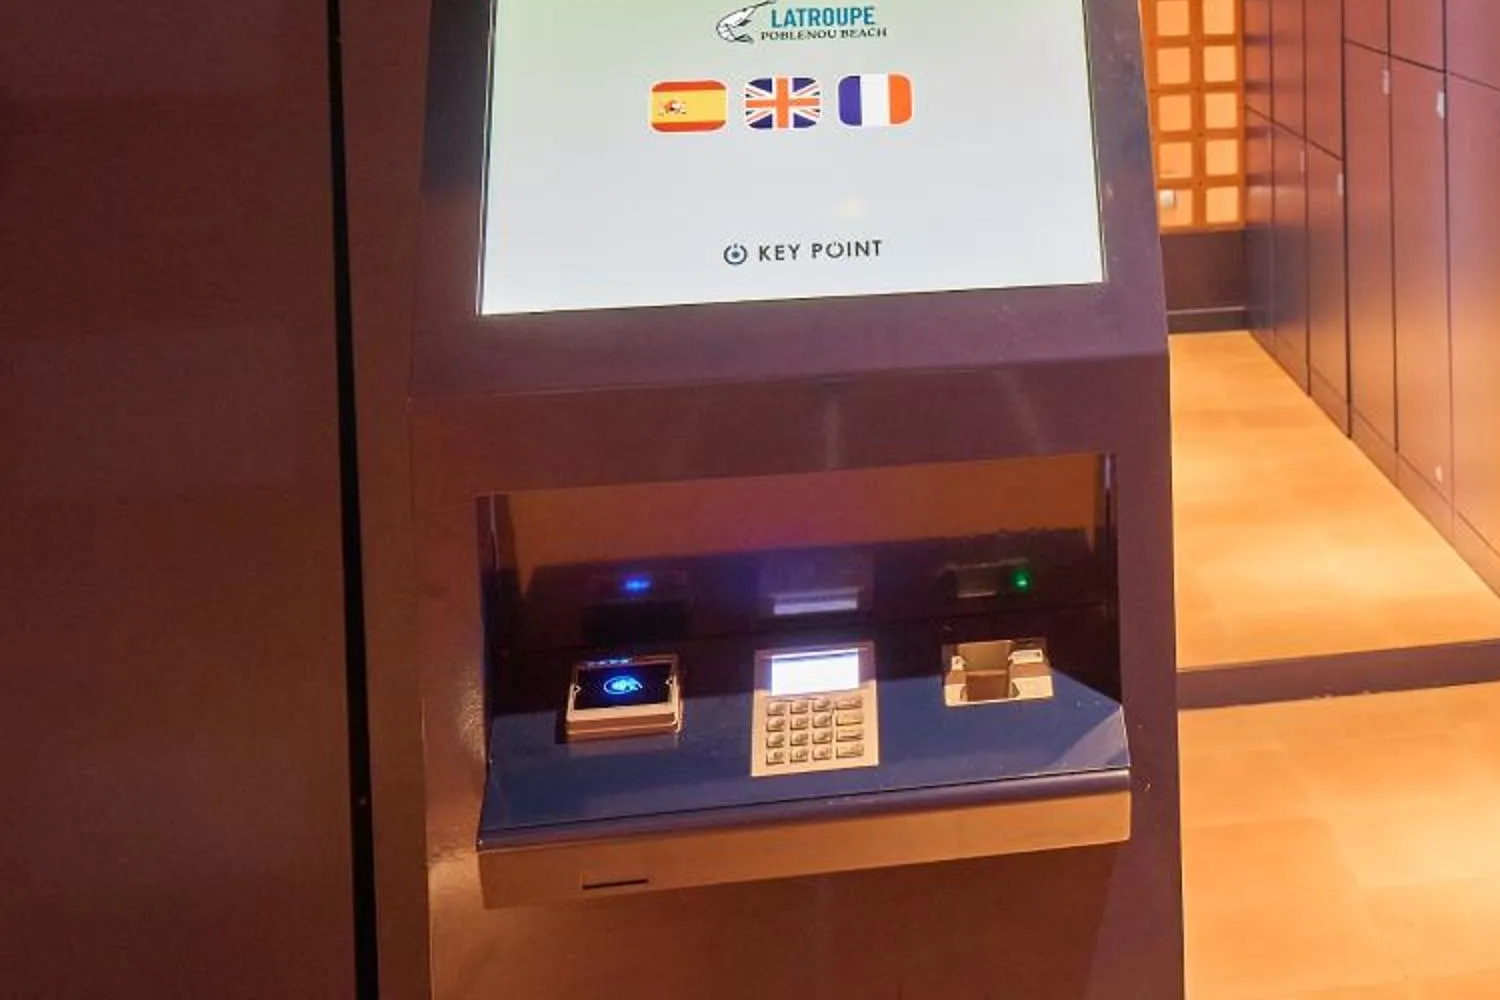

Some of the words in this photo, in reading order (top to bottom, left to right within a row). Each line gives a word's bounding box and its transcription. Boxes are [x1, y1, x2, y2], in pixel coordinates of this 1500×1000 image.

[771, 5, 875, 28] LATROUPE
[760, 29, 837, 41] POBLENOU
[840, 27, 887, 38] BEACH
[758, 243, 801, 262] KEY
[811, 240, 882, 259] POINT
